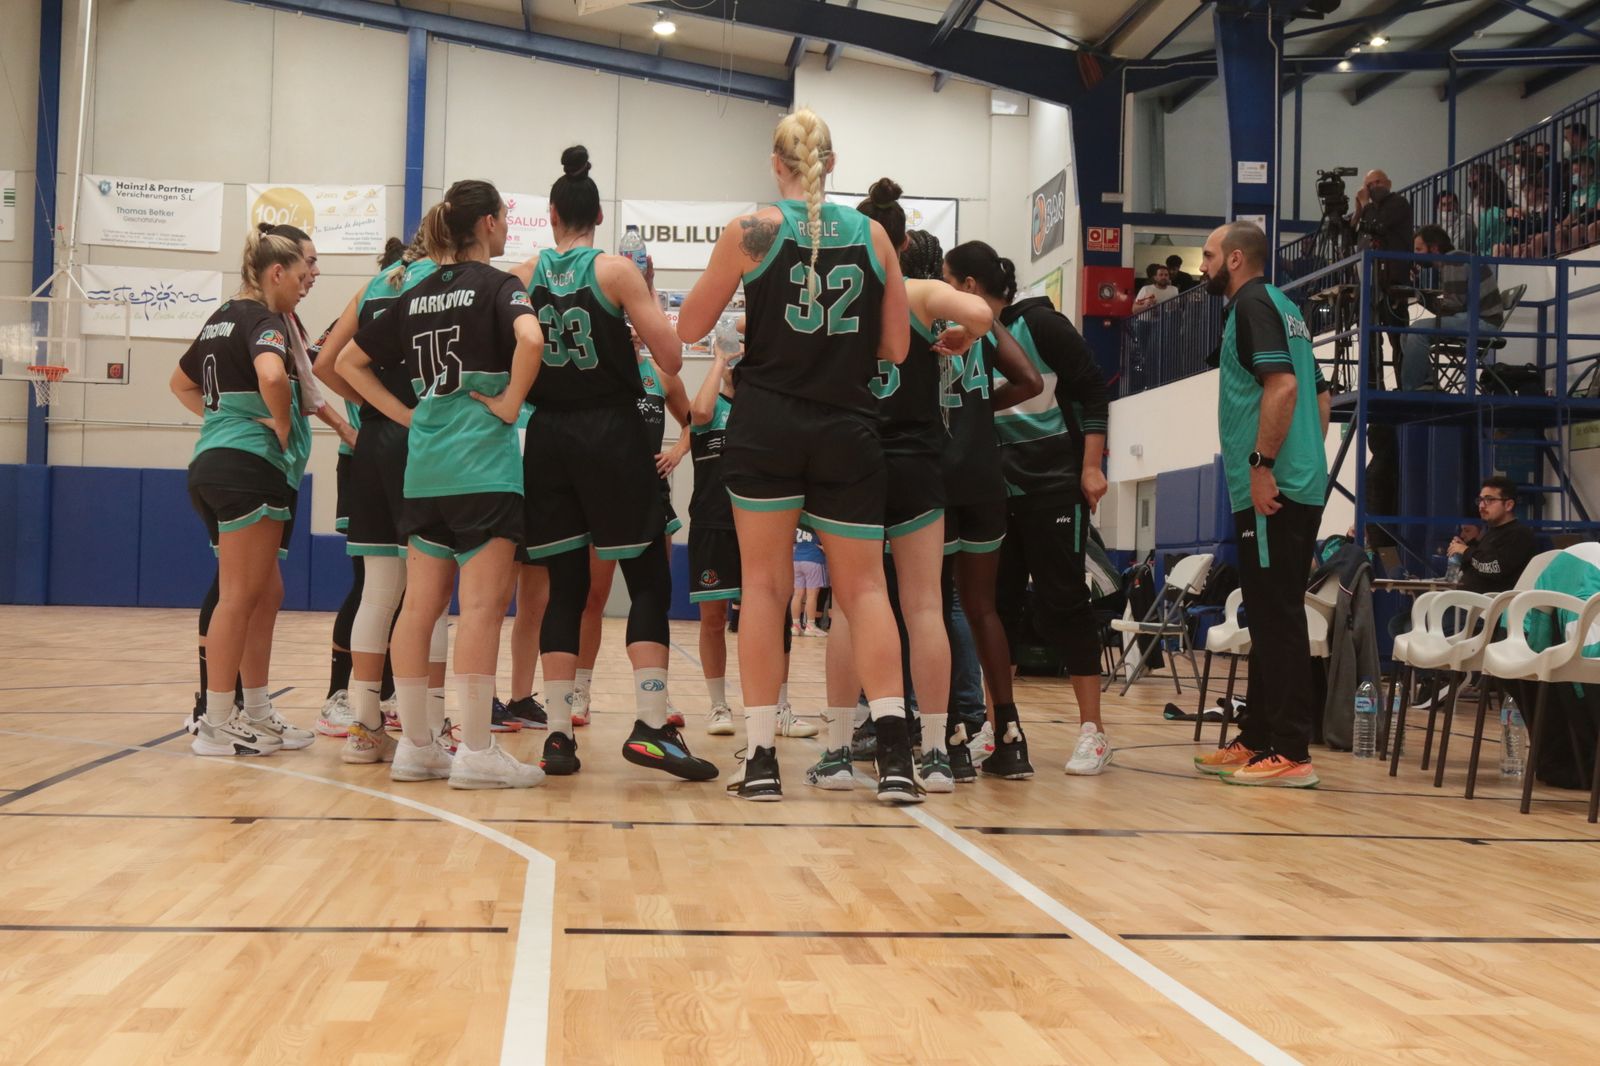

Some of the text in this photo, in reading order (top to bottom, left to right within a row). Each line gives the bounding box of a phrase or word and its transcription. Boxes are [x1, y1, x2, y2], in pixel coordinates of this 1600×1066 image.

[116, 181, 195, 194] Hainzl & Partner
[116, 190, 178, 202] Versicherungen
[116, 207, 147, 216] Thomas
[506, 215, 548, 228] SALUD
[640, 224, 727, 243] UBLILU
[409, 289, 476, 316] MARKOVIC
[784, 261, 864, 337] 32
[537, 303, 599, 371] 33
[412, 325, 463, 400] 15
